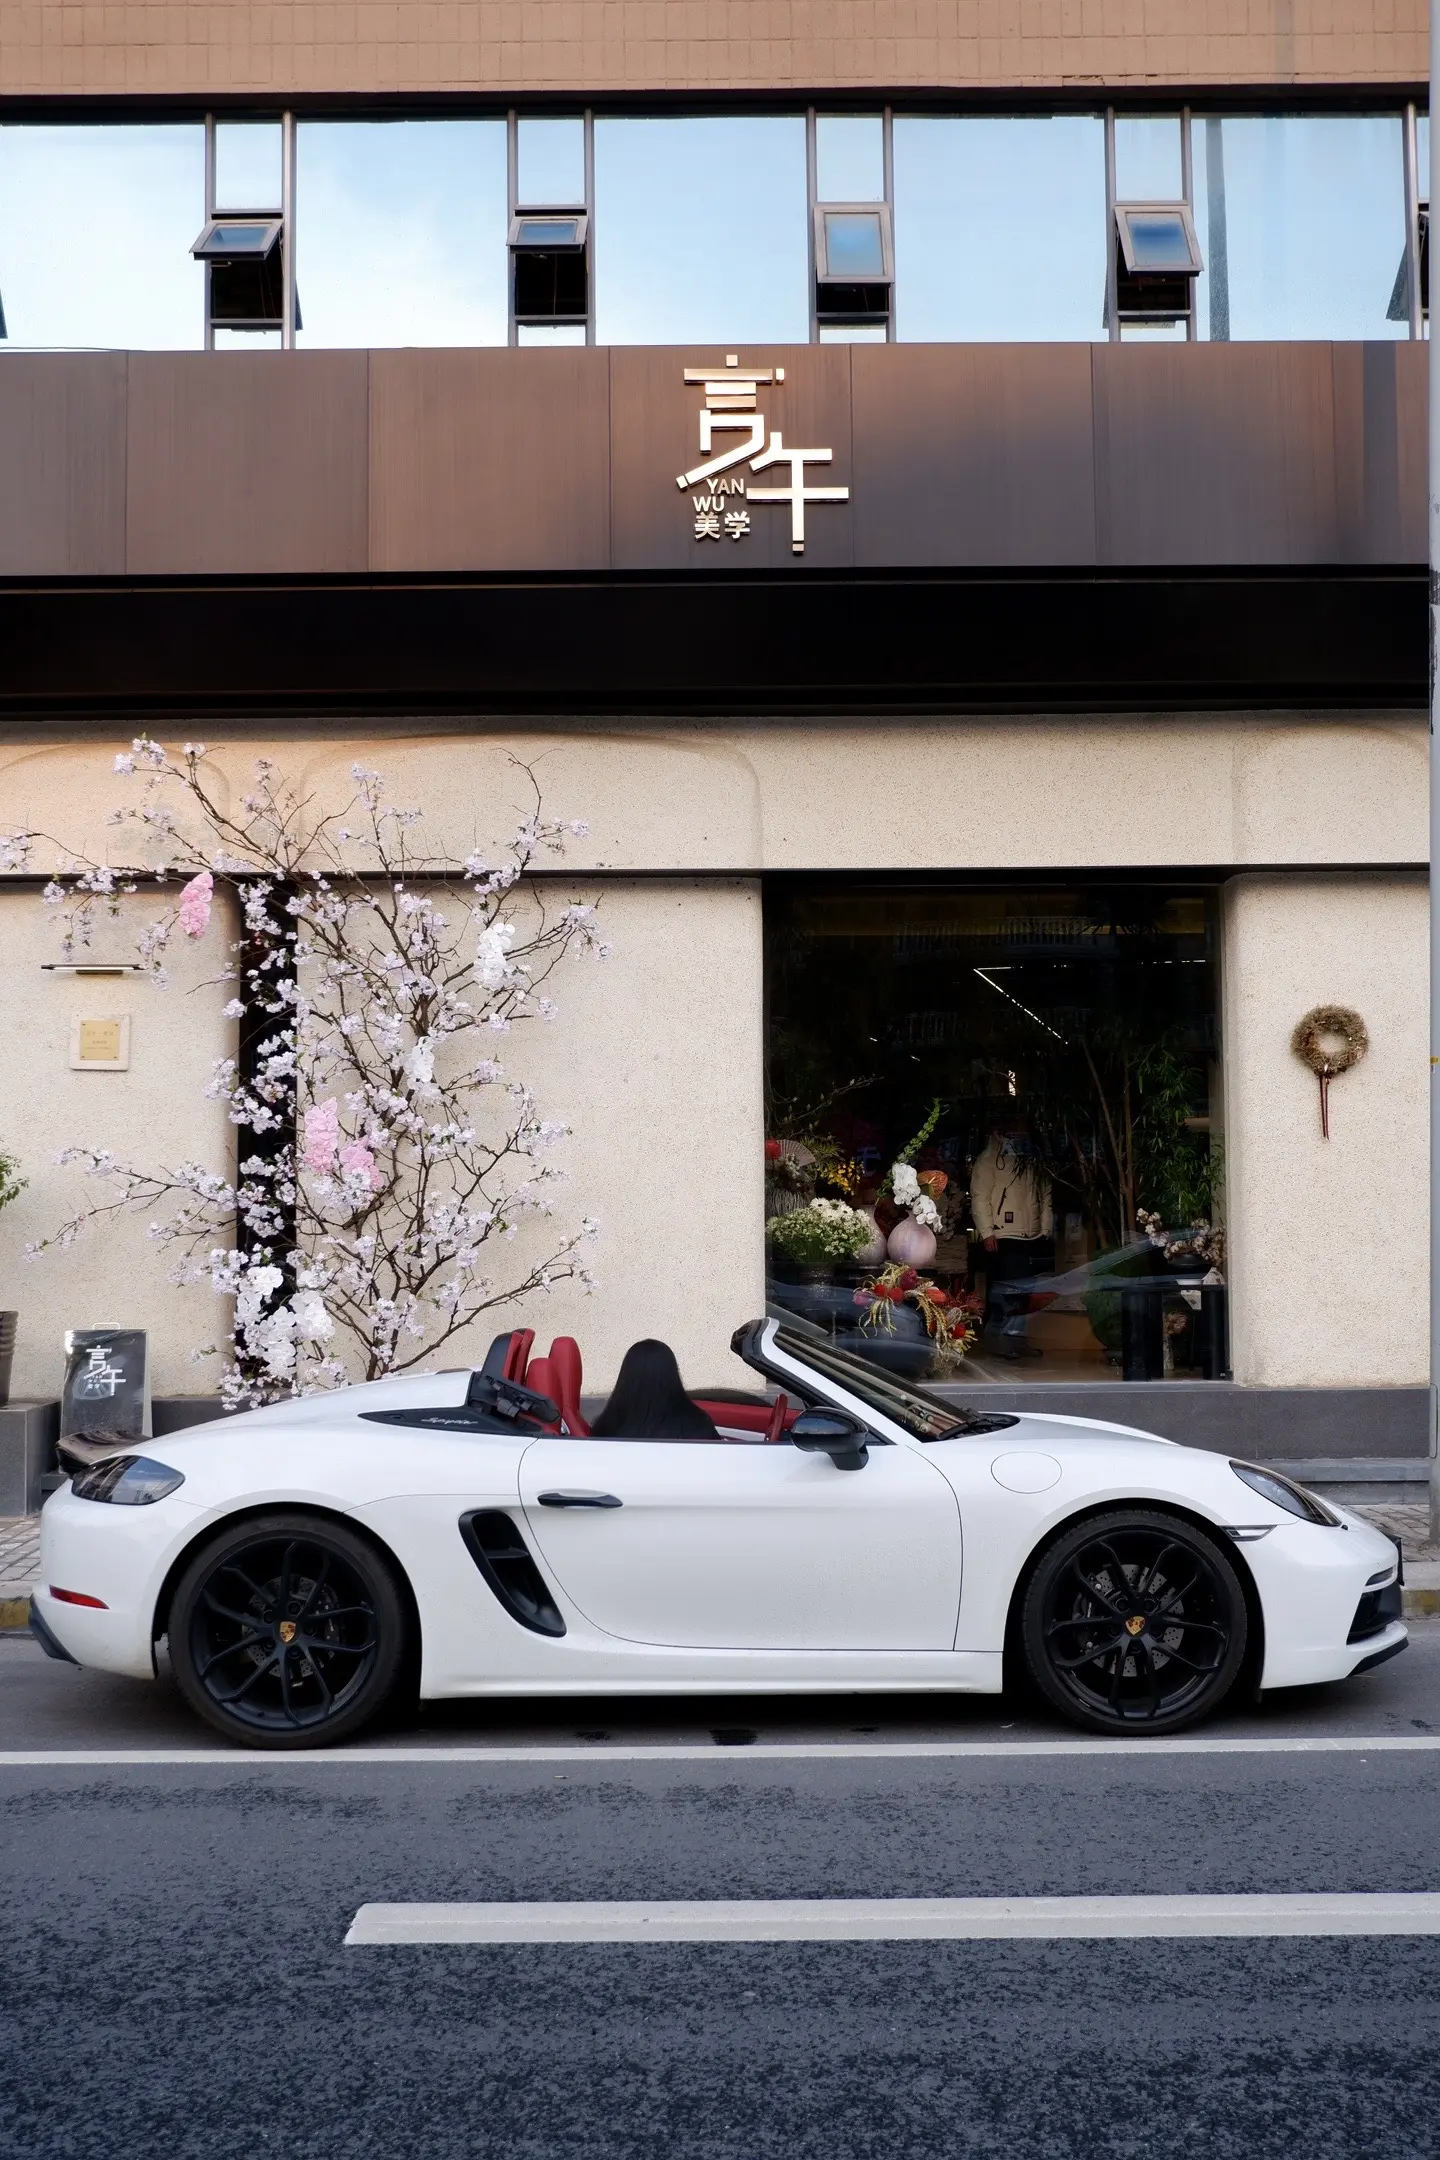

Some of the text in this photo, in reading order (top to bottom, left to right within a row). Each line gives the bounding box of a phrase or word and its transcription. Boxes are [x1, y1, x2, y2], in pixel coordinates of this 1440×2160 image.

[707, 479, 744, 494] YAN
[693, 497, 725, 512] WU
[694, 511, 750, 539] 美学
